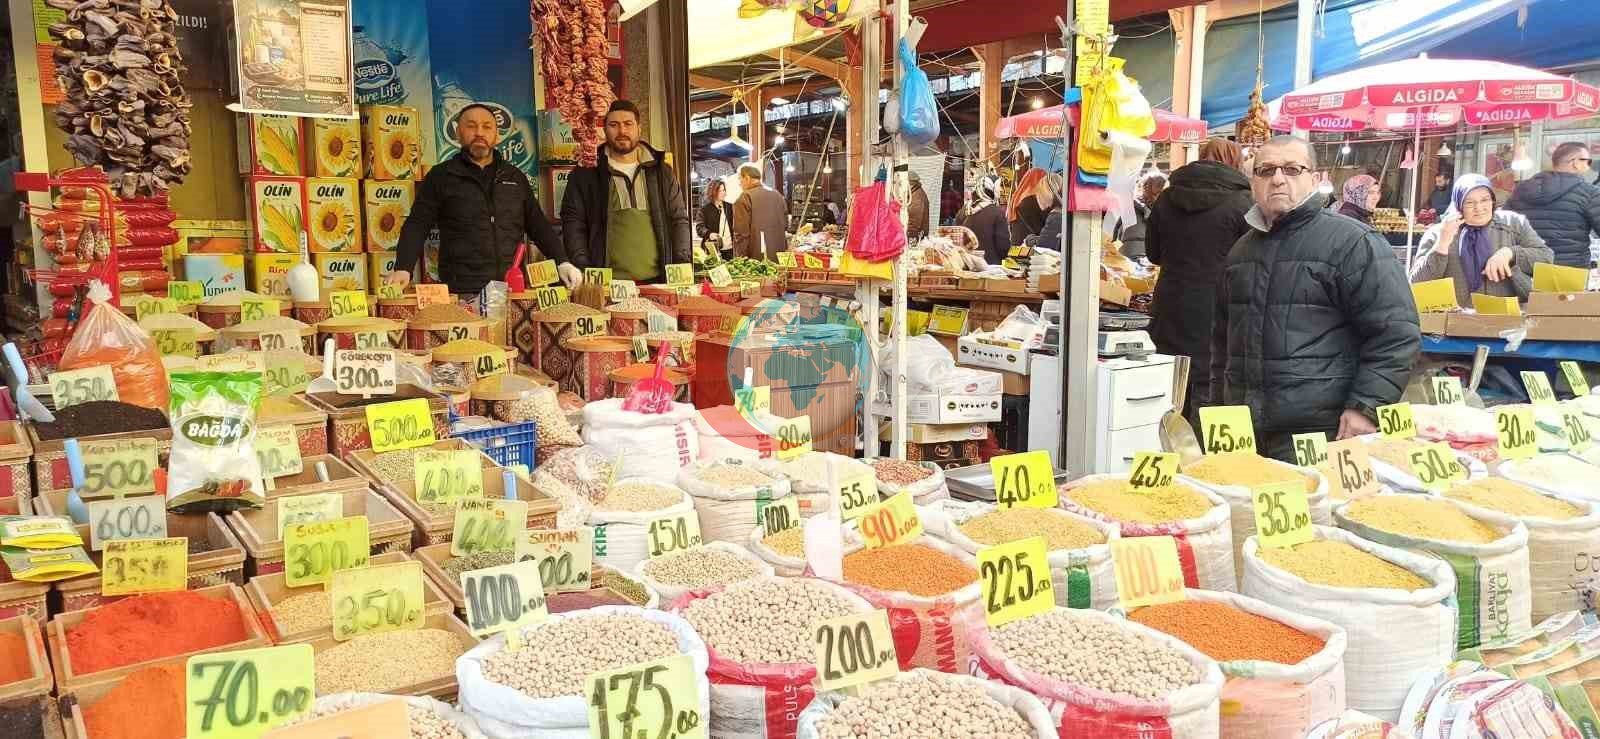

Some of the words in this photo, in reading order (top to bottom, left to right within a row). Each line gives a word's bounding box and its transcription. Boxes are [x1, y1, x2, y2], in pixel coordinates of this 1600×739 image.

[576, 317, 602, 336] 90.00
[340, 365, 393, 390] 300.00
[1437, 380, 1461, 405] 65.00
[777, 423, 811, 451] 80.00
[1207, 423, 1253, 454] 45.00
[1379, 411, 1412, 436] 50.00
[1497, 412, 1536, 450] 30.00
[1129, 455, 1172, 488] 45.00
[1338, 449, 1374, 494] 45.00
[1411, 448, 1461, 484] 50.00
[840, 482, 877, 511] 55.00
[998, 464, 1052, 509] 40.00
[862, 507, 917, 548] 90.00
[1257, 491, 1308, 538] 35.00
[648, 516, 700, 557] 150.00
[465, 573, 545, 630] 100.00
[981, 551, 1051, 616] 225.00
[192, 659, 310, 731] 70.00
[590, 664, 699, 739] 175.00
